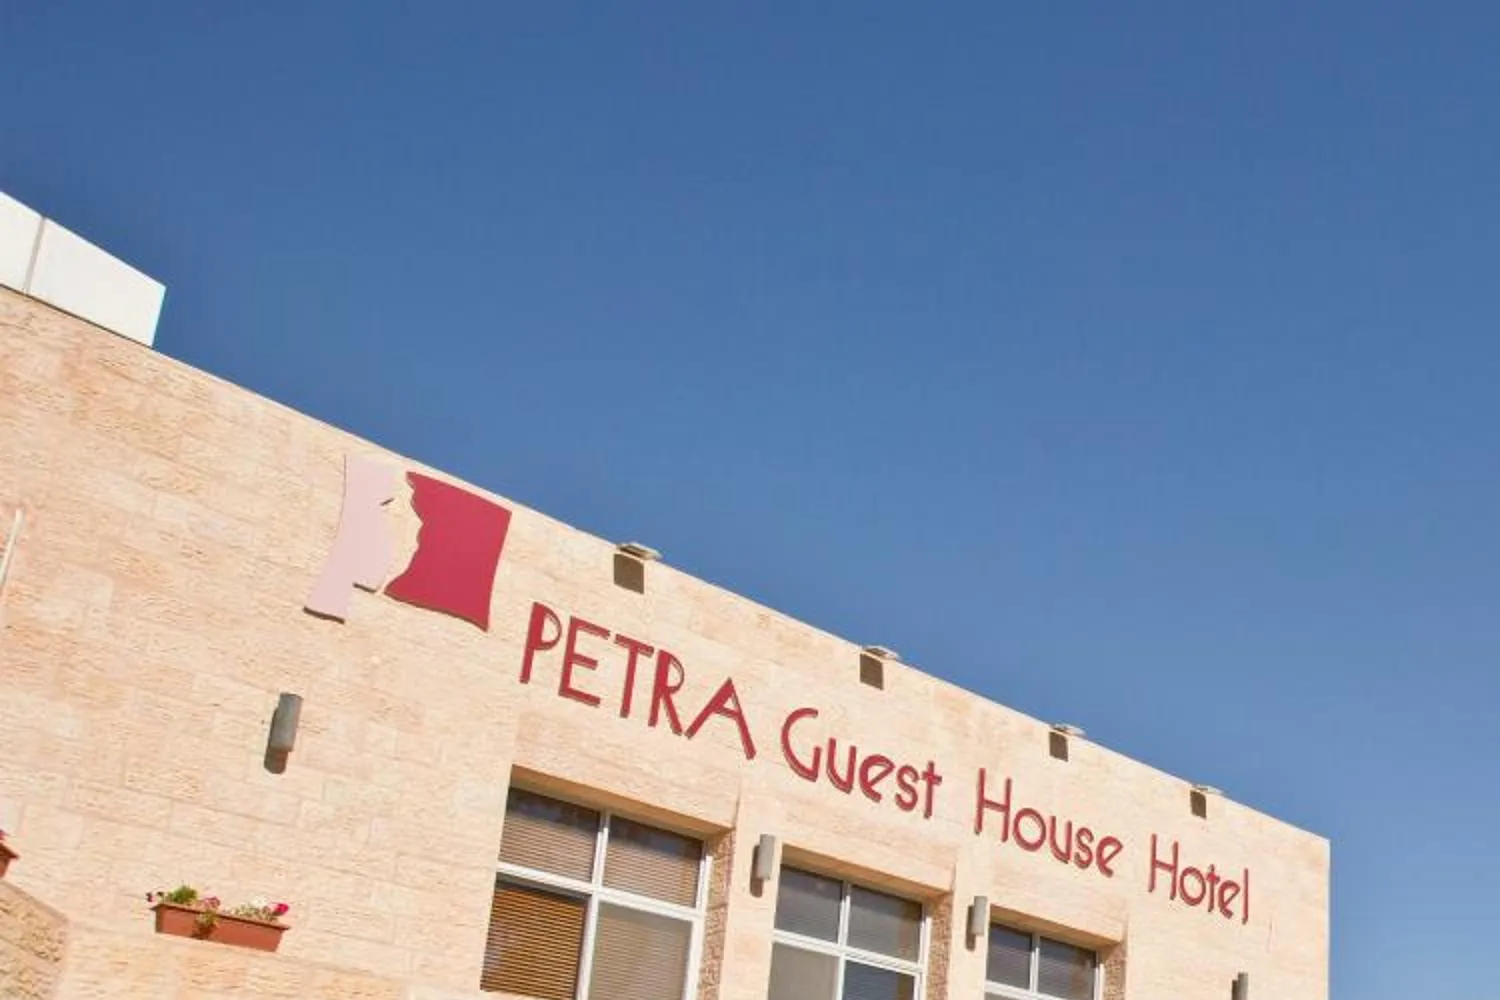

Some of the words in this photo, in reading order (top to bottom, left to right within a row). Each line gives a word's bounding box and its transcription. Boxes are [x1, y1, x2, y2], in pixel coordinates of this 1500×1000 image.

[520, 602, 757, 760] PETRA
[780, 707, 942, 819] Guest
[974, 767, 1123, 877] House
[1148, 833, 1249, 924] Hotel
